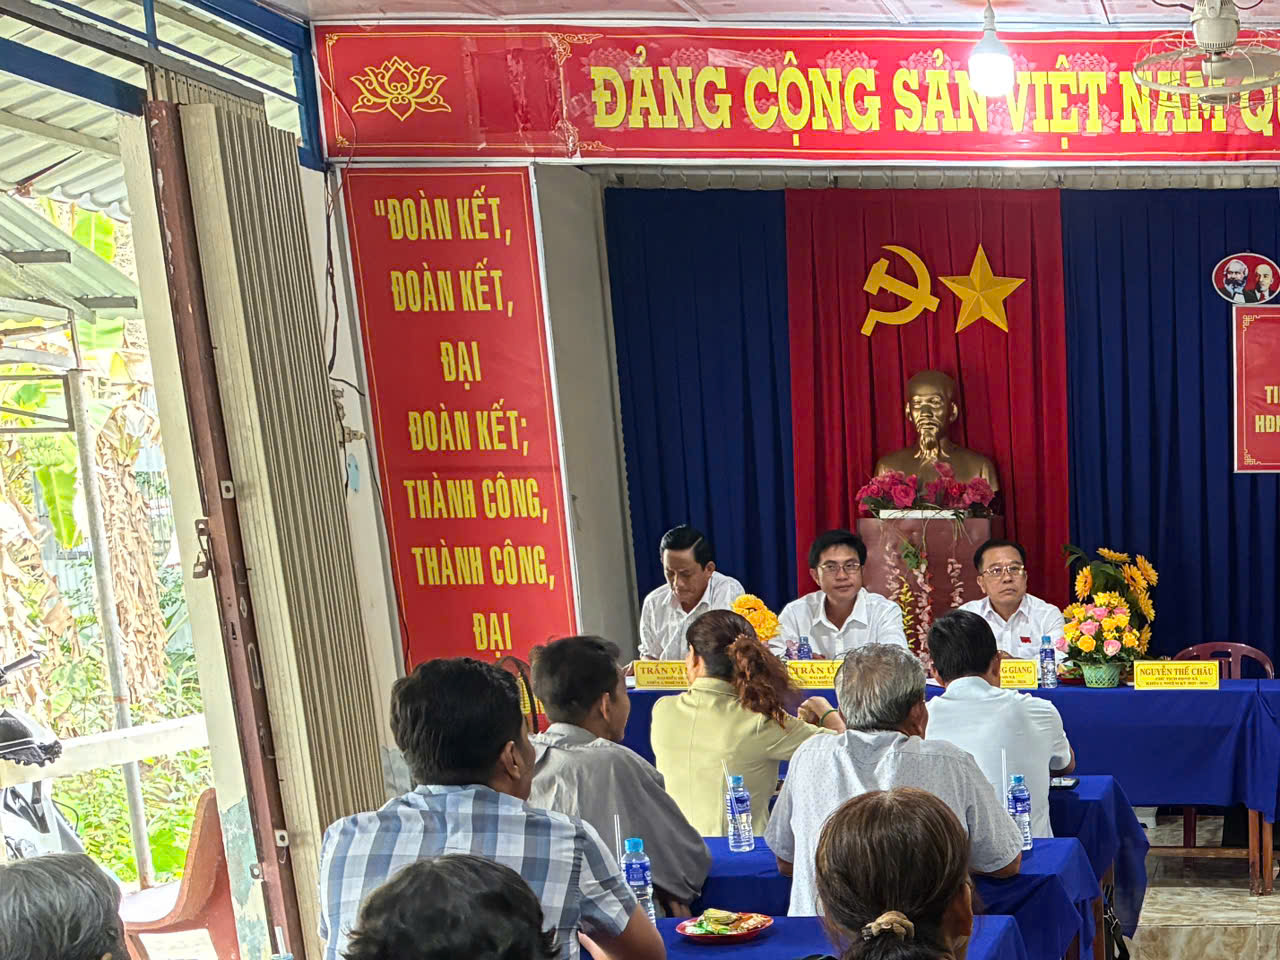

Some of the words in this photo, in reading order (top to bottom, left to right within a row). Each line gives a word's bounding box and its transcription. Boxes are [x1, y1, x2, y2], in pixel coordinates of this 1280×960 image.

[591, 45, 732, 130] ĐẢNG
[746, 55, 880, 147] CỘNG
[893, 48, 988, 132] SẢN
[1005, 54, 1107, 149] VIỆT
[1119, 70, 1226, 133] NAM
[374, 188, 452, 241] "ĐOÀN
[456, 185, 511, 246] KẾT,
[390, 262, 454, 312] ĐOÀN
[460, 256, 514, 318] KẾT,
[440, 341, 482, 390] ĐẠI
[408, 402, 471, 452] ĐOÀN
[476, 398, 529, 456] KẾT;
[403, 472, 477, 519] THÀNH
[481, 471, 548, 523] CÔNG,
[411, 539, 485, 586] THÀNH
[488, 538, 555, 591] CÔNG,
[472, 612, 513, 658] ĐẠI
[640, 661, 668, 675] TRẦN
[671, 662, 687, 675] VĂ
[1008, 666, 1032, 674] GIANG
[1140, 665, 1173, 676] NGUYỄN
[1173, 665, 1190, 676] THẾ
[1191, 666, 1214, 676] CHÂU
